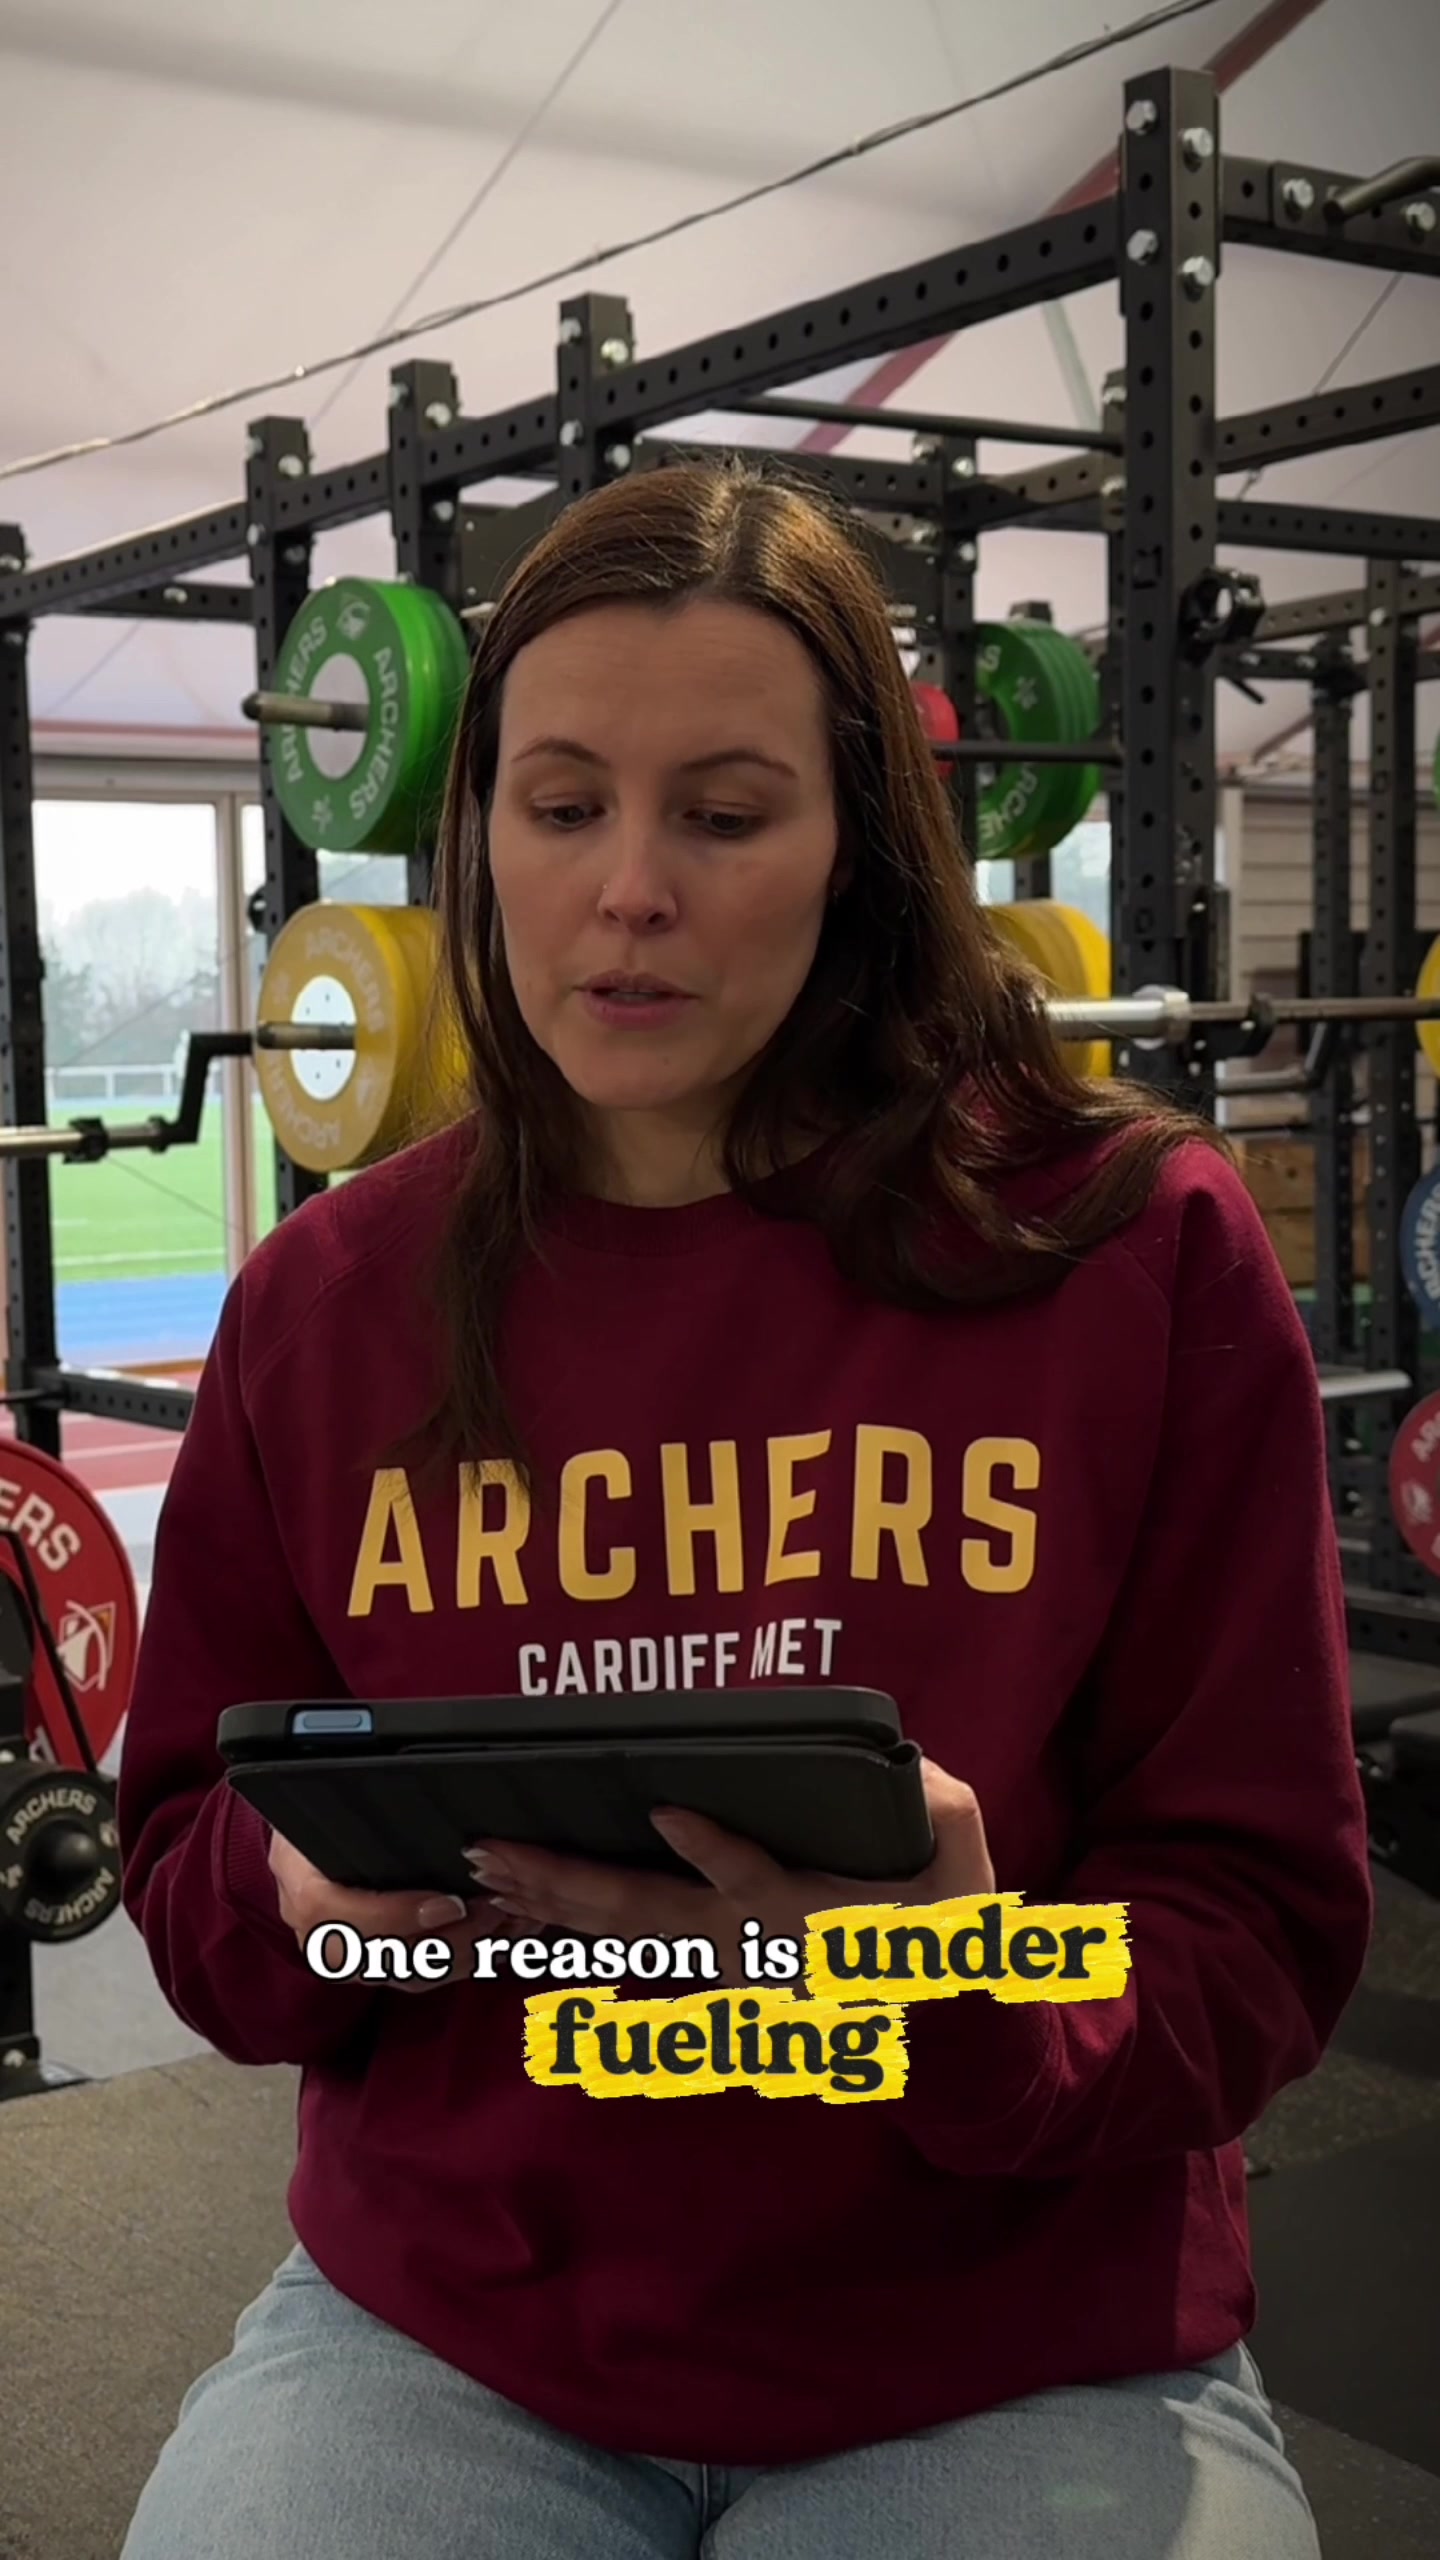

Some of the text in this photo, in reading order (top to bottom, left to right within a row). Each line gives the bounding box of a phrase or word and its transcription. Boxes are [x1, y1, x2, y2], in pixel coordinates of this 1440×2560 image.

[349, 645, 399, 820] ARCHERS
[347, 1424, 1041, 1617] ARCHERS
[518, 1618, 843, 1696] CARDIFF MET
[6, 1787, 97, 1845] ARCHERS
[25, 1867, 115, 1925] ARCHERS
